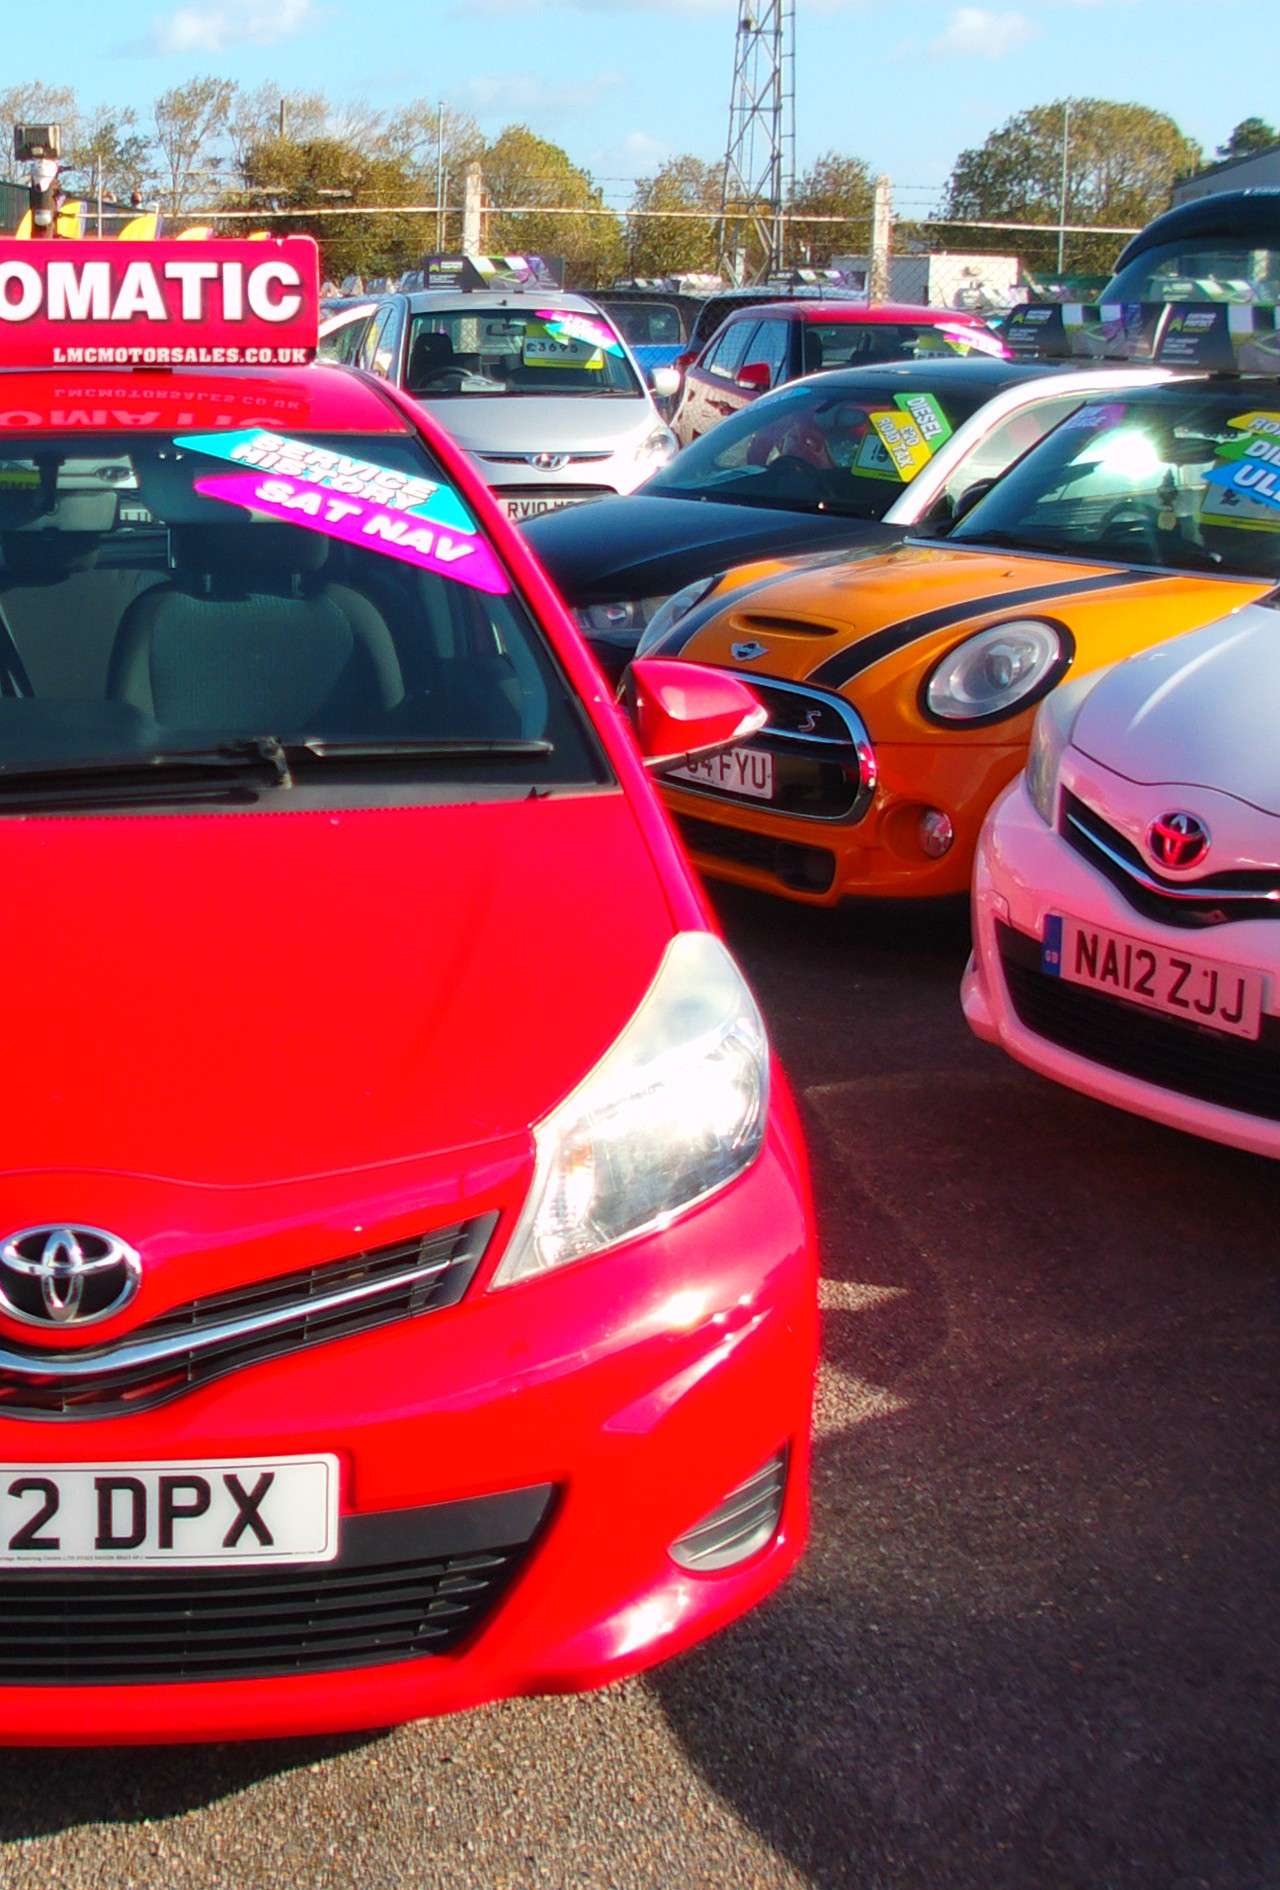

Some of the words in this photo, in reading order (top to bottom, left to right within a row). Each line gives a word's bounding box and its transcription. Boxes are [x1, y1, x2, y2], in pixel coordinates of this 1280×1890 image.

[53, 347, 306, 364] LMCMOTORSALES.CO.UK
[879, 416, 901, 443] ROAD
[892, 443, 914, 468] TAX
[906, 396, 943, 441] DIESEL
[232, 443, 429, 512] HISTORY
[250, 433, 441, 498] SERVICE
[255, 480, 364, 523] SAT
[362, 514, 476, 563] NAV
[719, 752, 766, 789] FYU
[1074, 929, 1156, 998] NA12
[1167, 957, 1245, 1024] ZJJ
[95, 1471, 276, 1550] DPX
